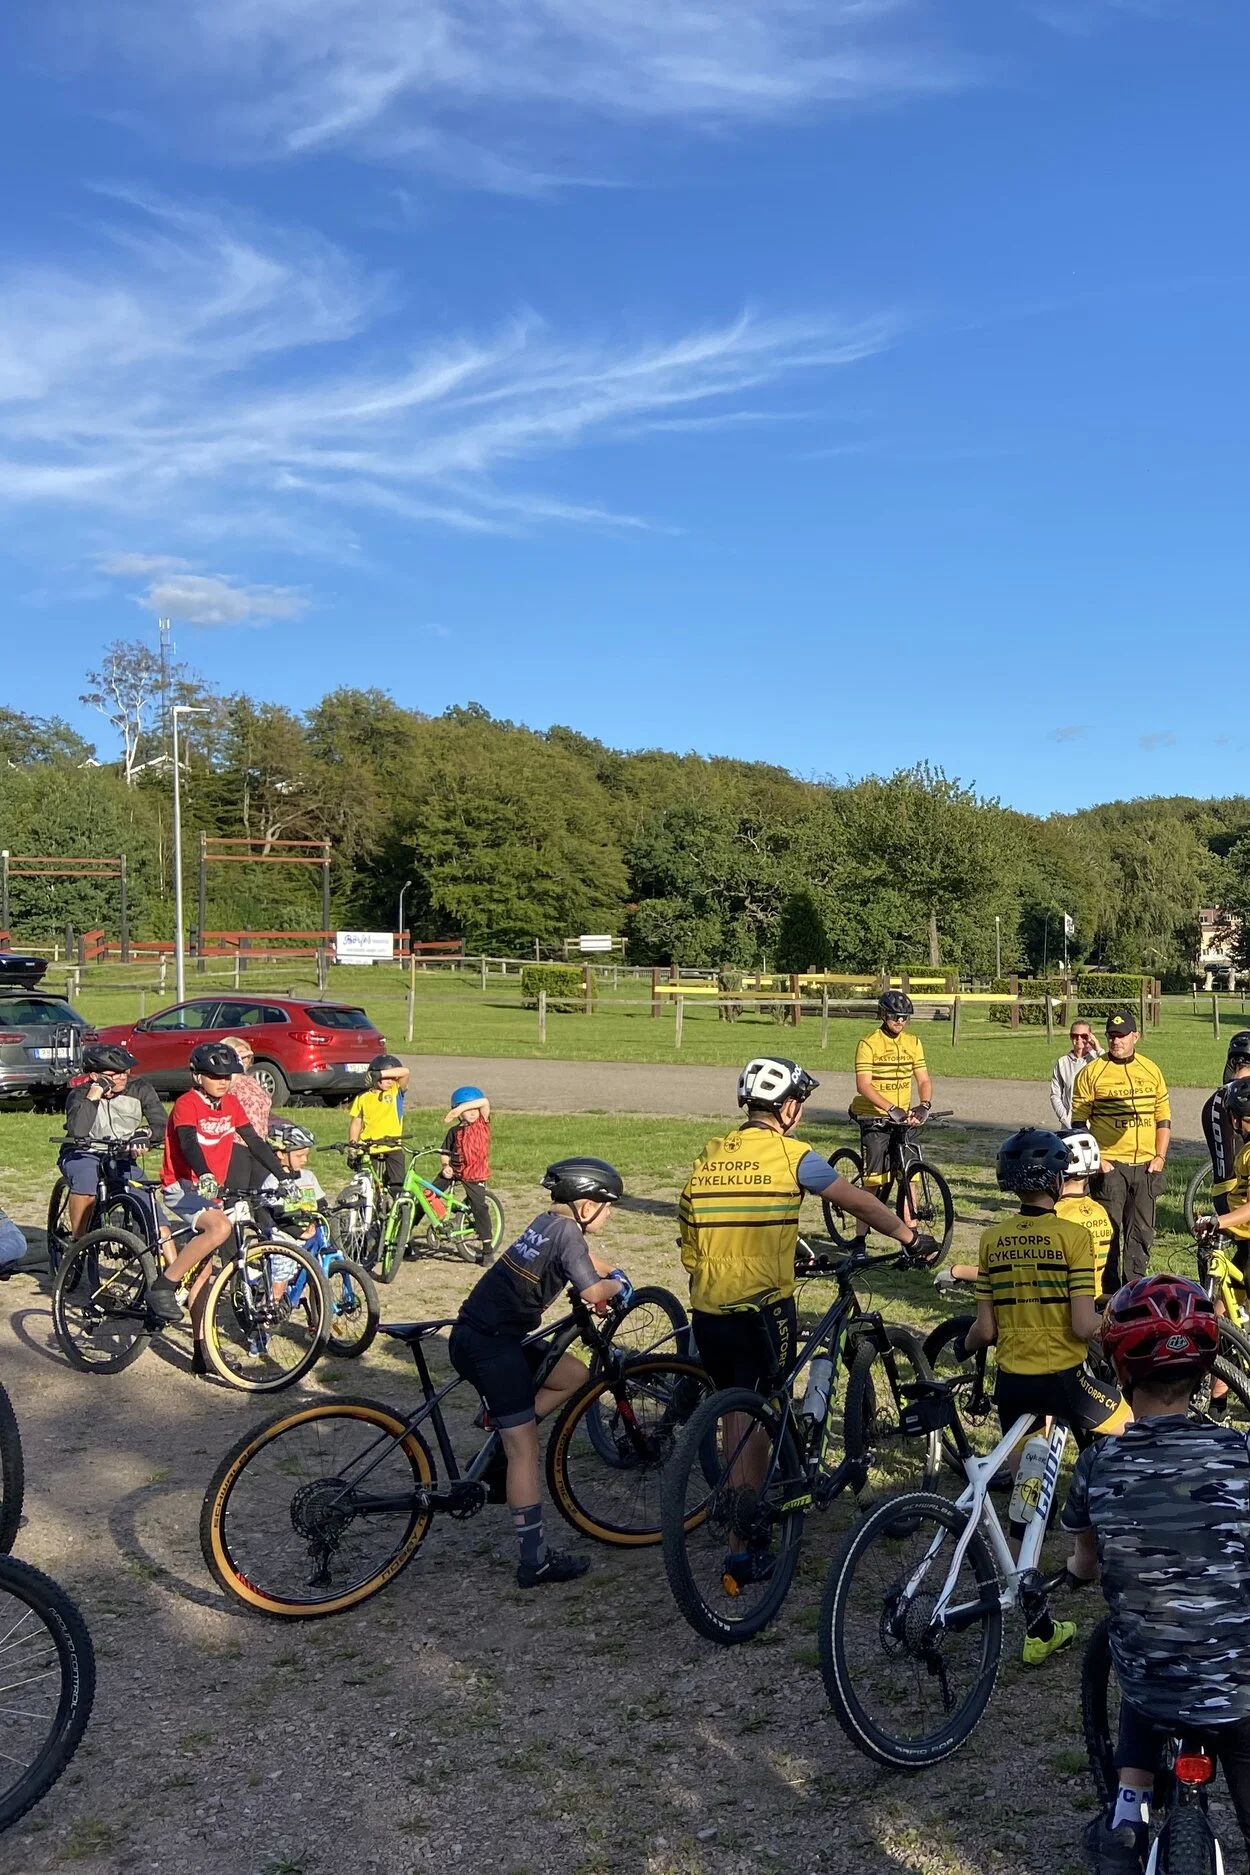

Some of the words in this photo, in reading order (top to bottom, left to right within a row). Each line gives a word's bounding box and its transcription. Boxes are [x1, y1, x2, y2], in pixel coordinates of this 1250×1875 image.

[1212, 1092, 1226, 1179] SCOTT
[690, 1174, 772, 1187] CYKELKLUBB
[988, 1249, 1063, 1263] CYKELKLUBB
[1105, 1398, 1118, 1411] CK
[70, 1653, 80, 1710] CONTROL
